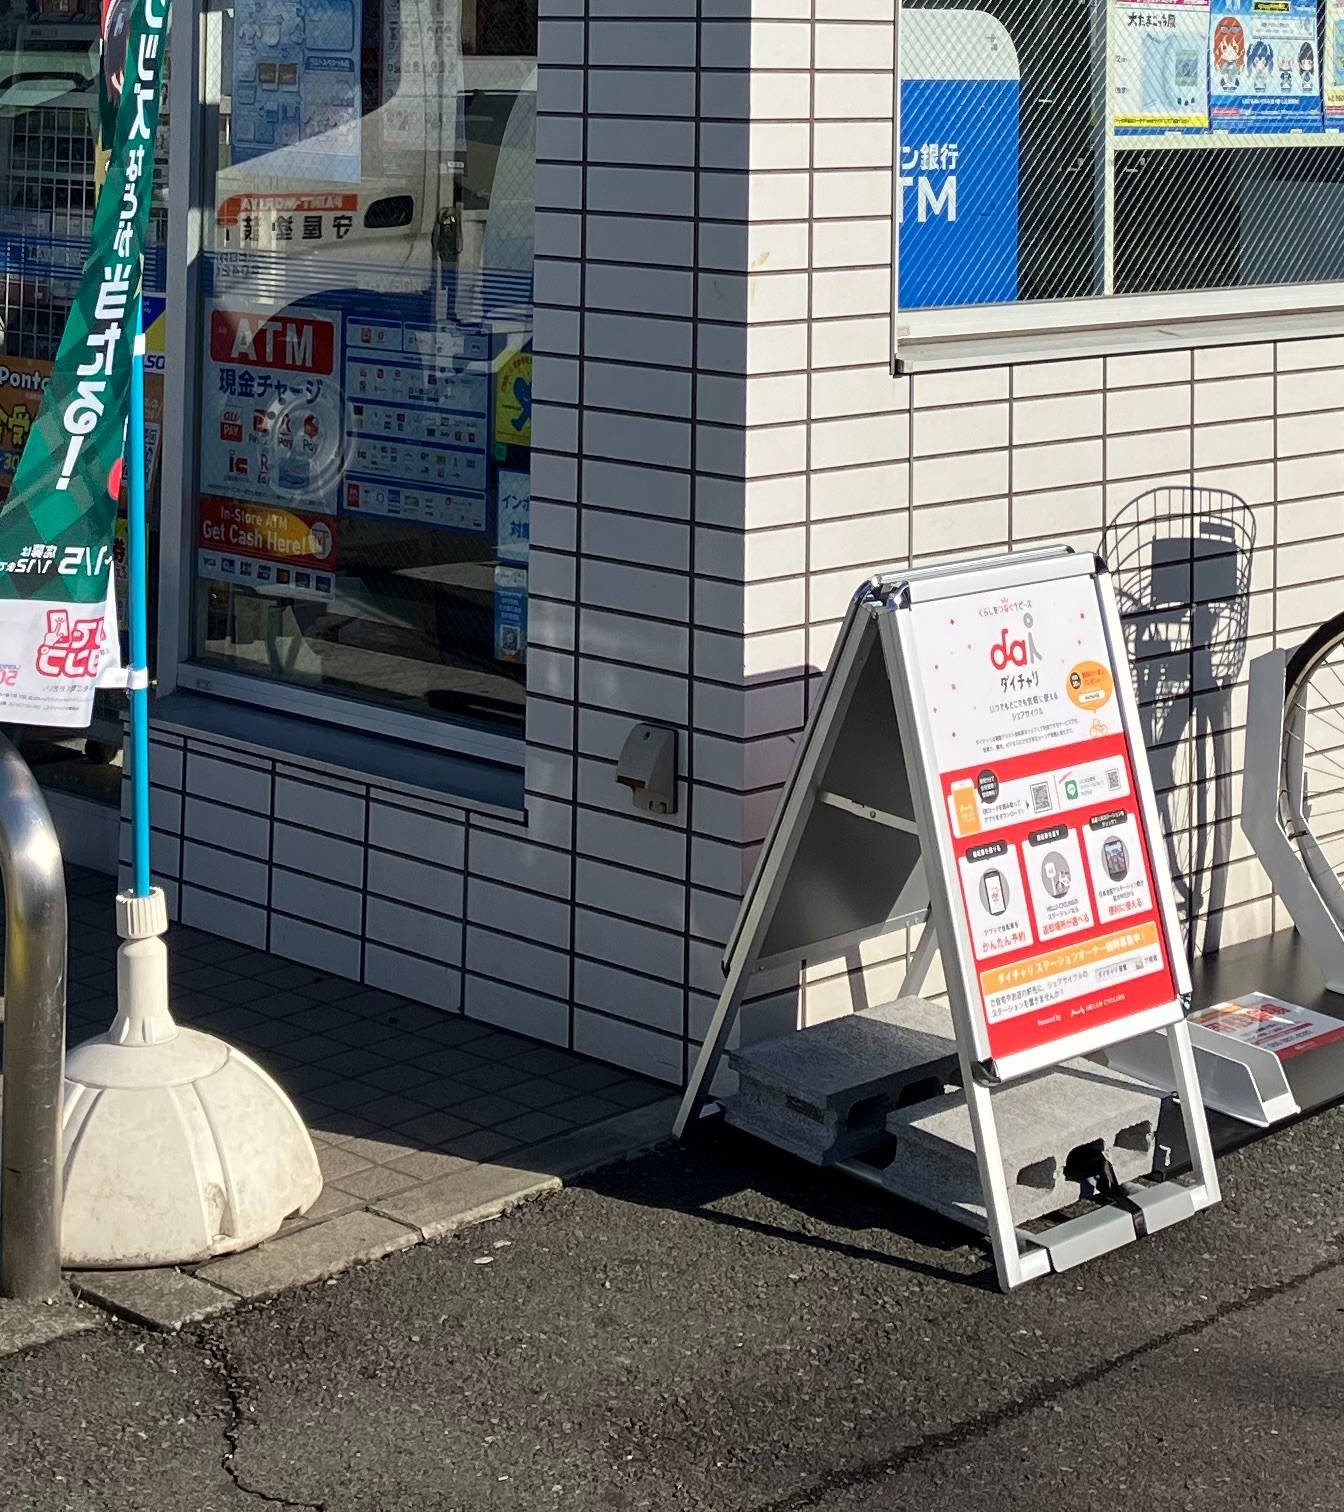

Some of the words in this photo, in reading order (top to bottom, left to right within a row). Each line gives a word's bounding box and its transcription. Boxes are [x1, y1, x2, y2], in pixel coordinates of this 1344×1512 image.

[1128, 12, 1176, 28] 大たまごっち展
[230, 318, 313, 368] ATM
[219, 368, 323, 404] 現金チャージ
[220, 506, 263, 526] In-Store
[266, 514, 288, 529] ATM
[202, 519, 226, 541] Get
[229, 524, 263, 548] Cash
[267, 530, 306, 555] Here!
[1000, 670, 1040, 694] ダイチャリ
[1108, 899, 1143, 916] 便利に使える
[982, 931, 1026, 953] かんたん予約
